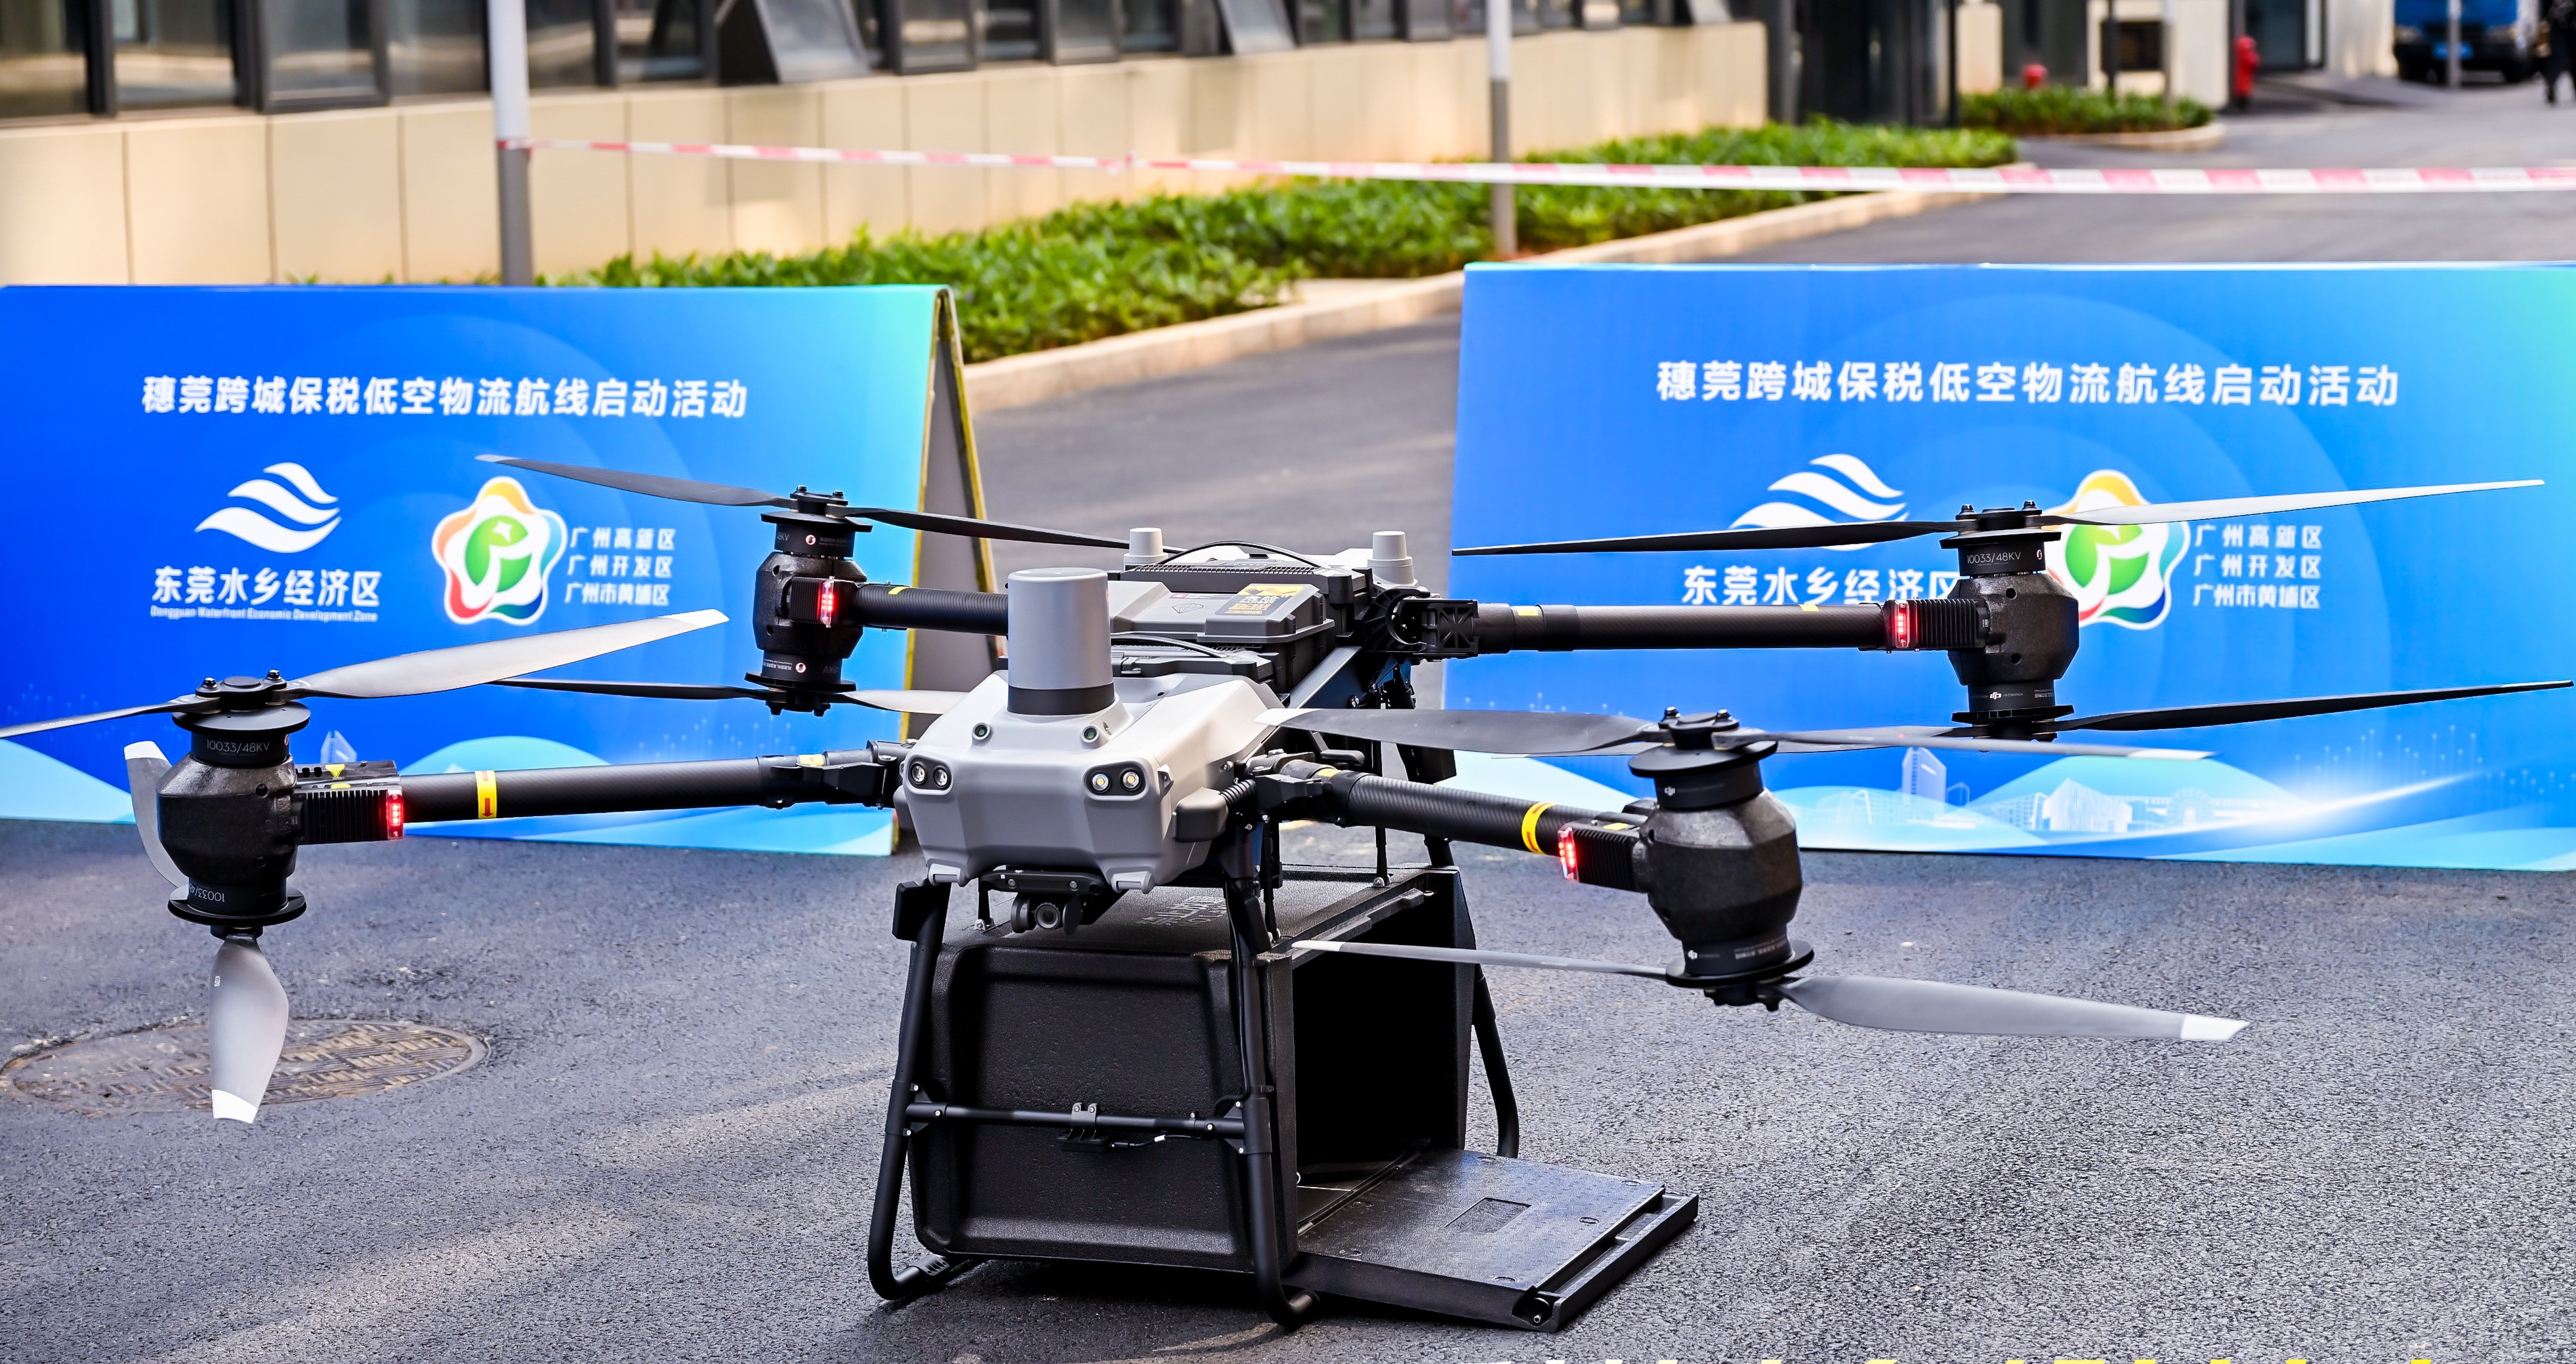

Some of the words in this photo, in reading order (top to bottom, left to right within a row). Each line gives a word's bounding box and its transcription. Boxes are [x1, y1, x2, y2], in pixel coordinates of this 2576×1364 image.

[1656, 360, 2399, 406] 穗莞跨城保税低空物流航线启动活动
[142, 375, 747, 418] 穗莞跨城保税低空物流航线启动活动
[570, 526, 676, 550] 广州高新区
[2195, 524, 2323, 549] 广州高新区
[567, 554, 673, 578] 广州开发区
[1966, 552, 2022, 564] 10033/48KV
[2193, 554, 2321, 579] 广州开发区
[152, 566, 383, 607] 东莞水乡经济区
[2193, 583, 2321, 609] 广州市黄埔区
[207, 739, 270, 754] 10033/48KV
